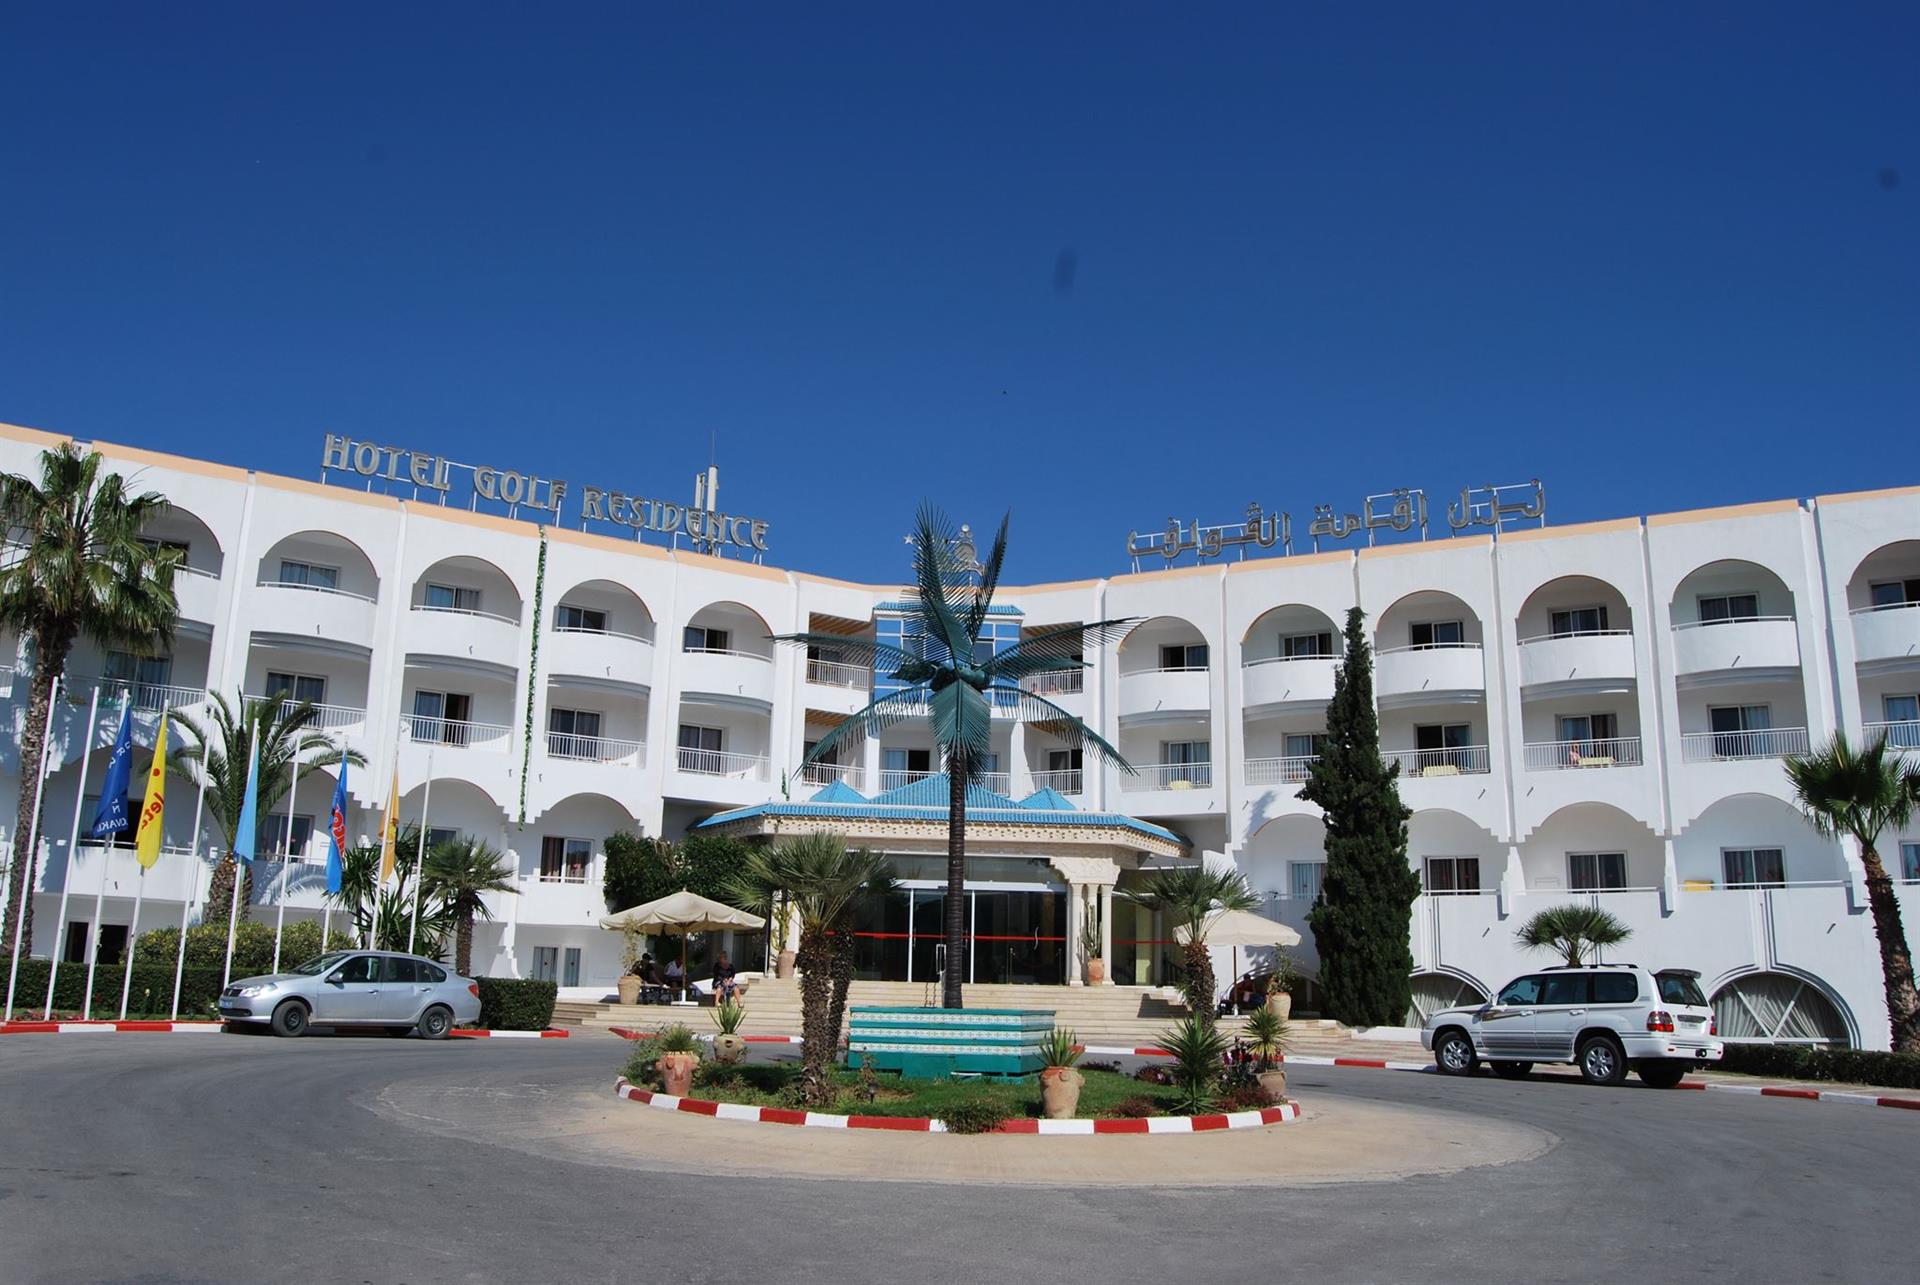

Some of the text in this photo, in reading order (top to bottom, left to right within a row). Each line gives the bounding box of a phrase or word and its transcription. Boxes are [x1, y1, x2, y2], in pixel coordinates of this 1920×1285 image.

[321, 433, 768, 550] HOTEL GOLF RESIDENCE
